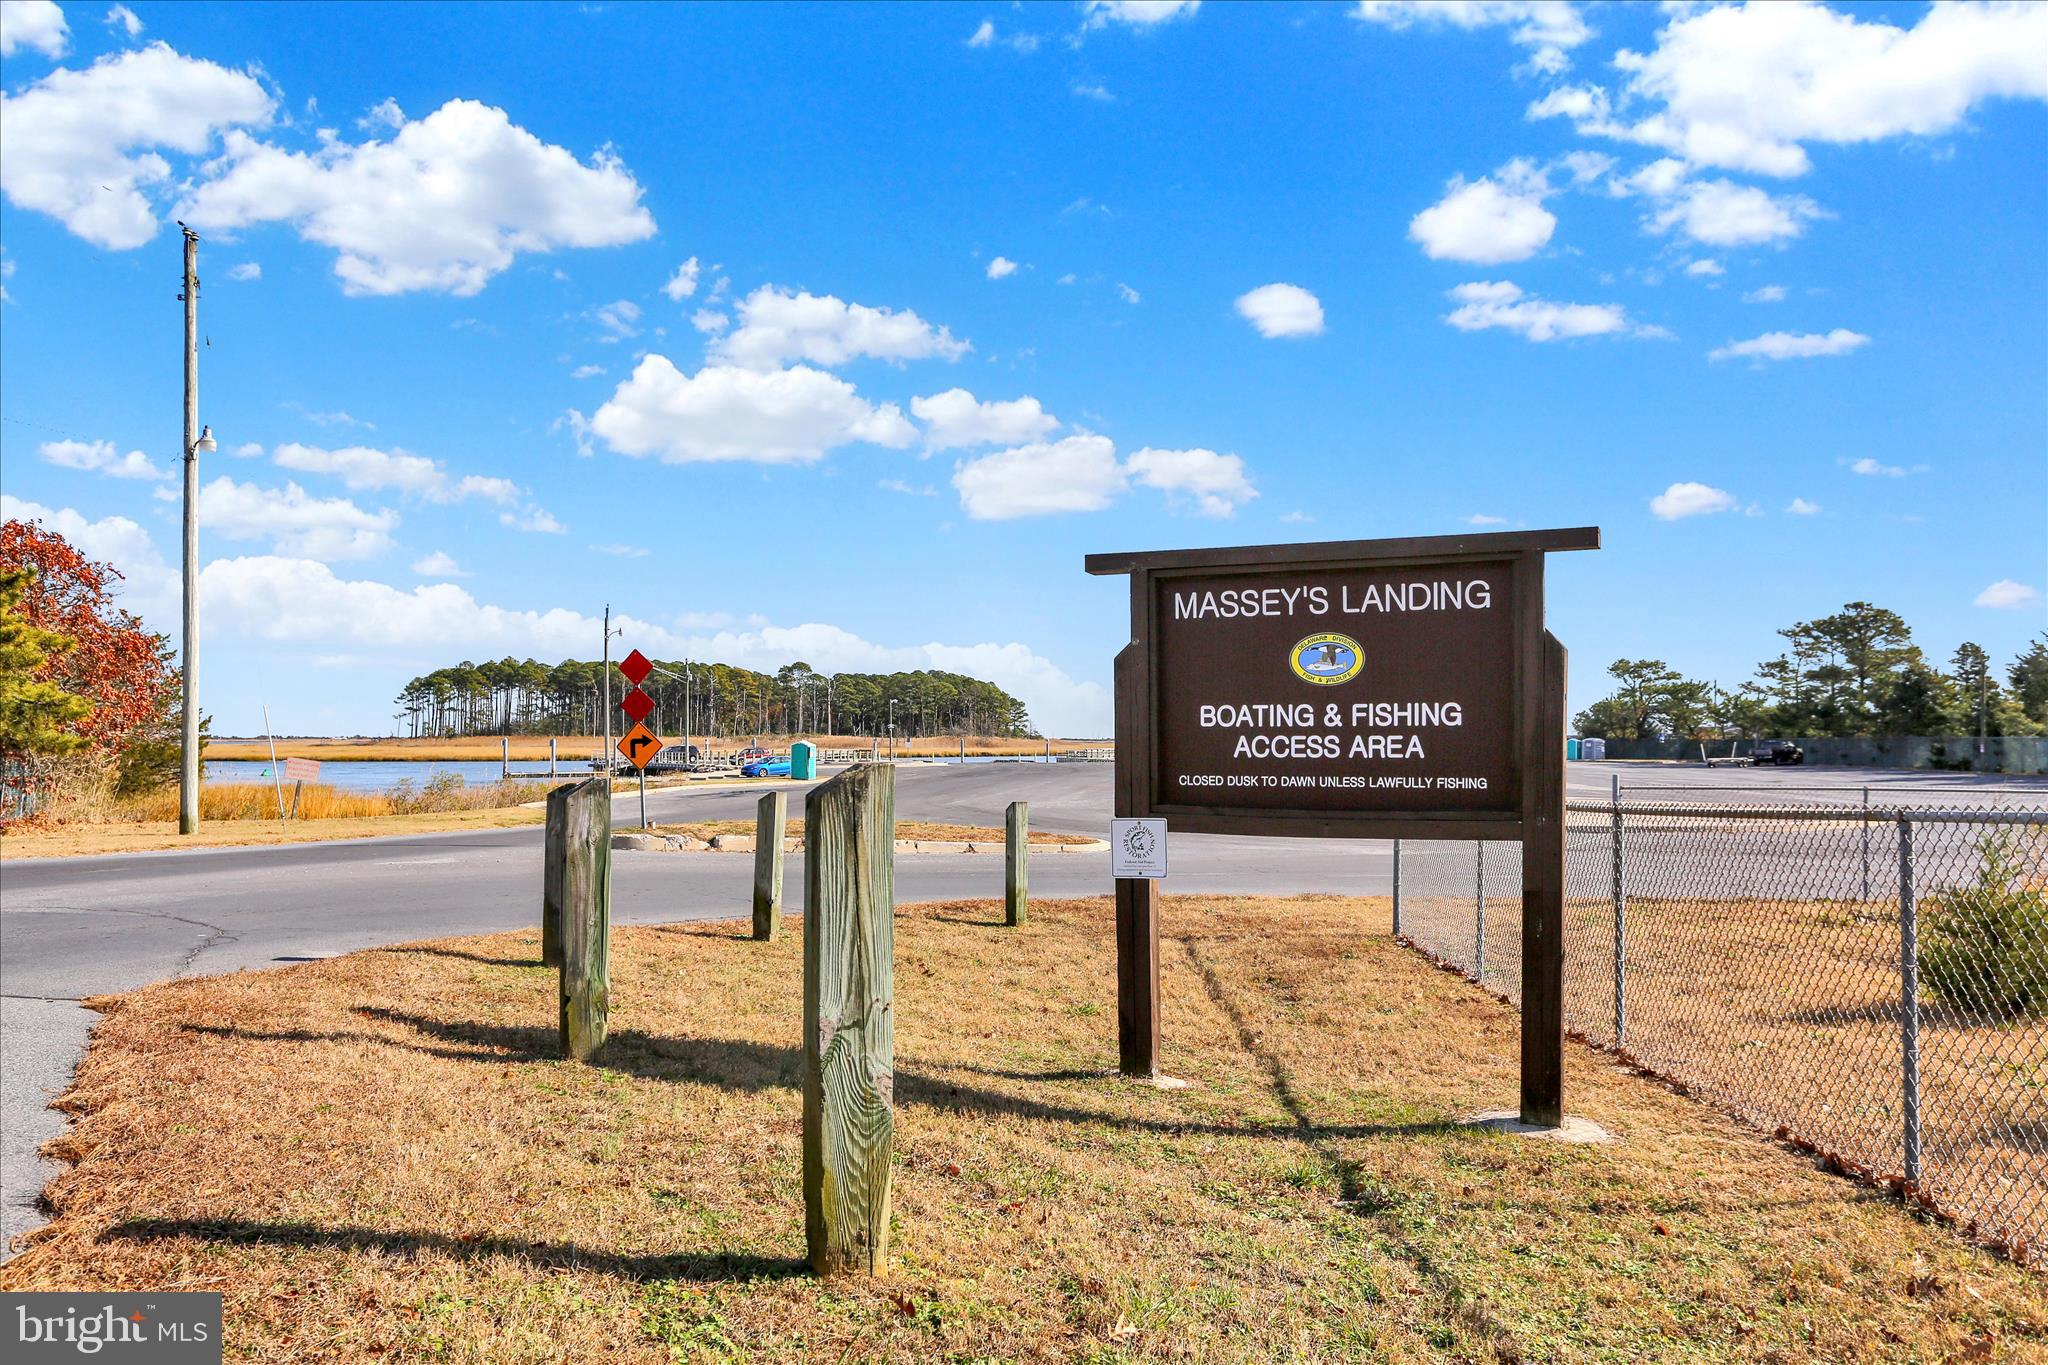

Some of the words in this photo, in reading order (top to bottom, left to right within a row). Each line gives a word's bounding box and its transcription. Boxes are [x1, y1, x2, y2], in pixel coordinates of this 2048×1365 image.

[1174, 585, 1329, 620] MASSEY'S
[1342, 579, 1491, 614] LANDING
[1298, 635, 1328, 651] DELAWARE
[1332, 635, 1357, 650] DIVISION
[1302, 672, 1315, 682] FISH
[1325, 671, 1351, 684] WILDLIFE
[1200, 703, 1315, 728] BOATING
[1323, 703, 1343, 728] &
[1351, 701, 1463, 727] FISHING
[1233, 734, 1341, 759] ACCESS
[1348, 734, 1425, 759] AREA
[1178, 774, 1224, 787] CLOSED
[1227, 775, 1259, 787] DUSK
[1260, 775, 1278, 787] TO
[1280, 775, 1316, 788] DAWN
[1319, 776, 1366, 788] UNLESS
[1369, 776, 1434, 789] LAWFULLY
[1436, 777, 1488, 790] FISHING
